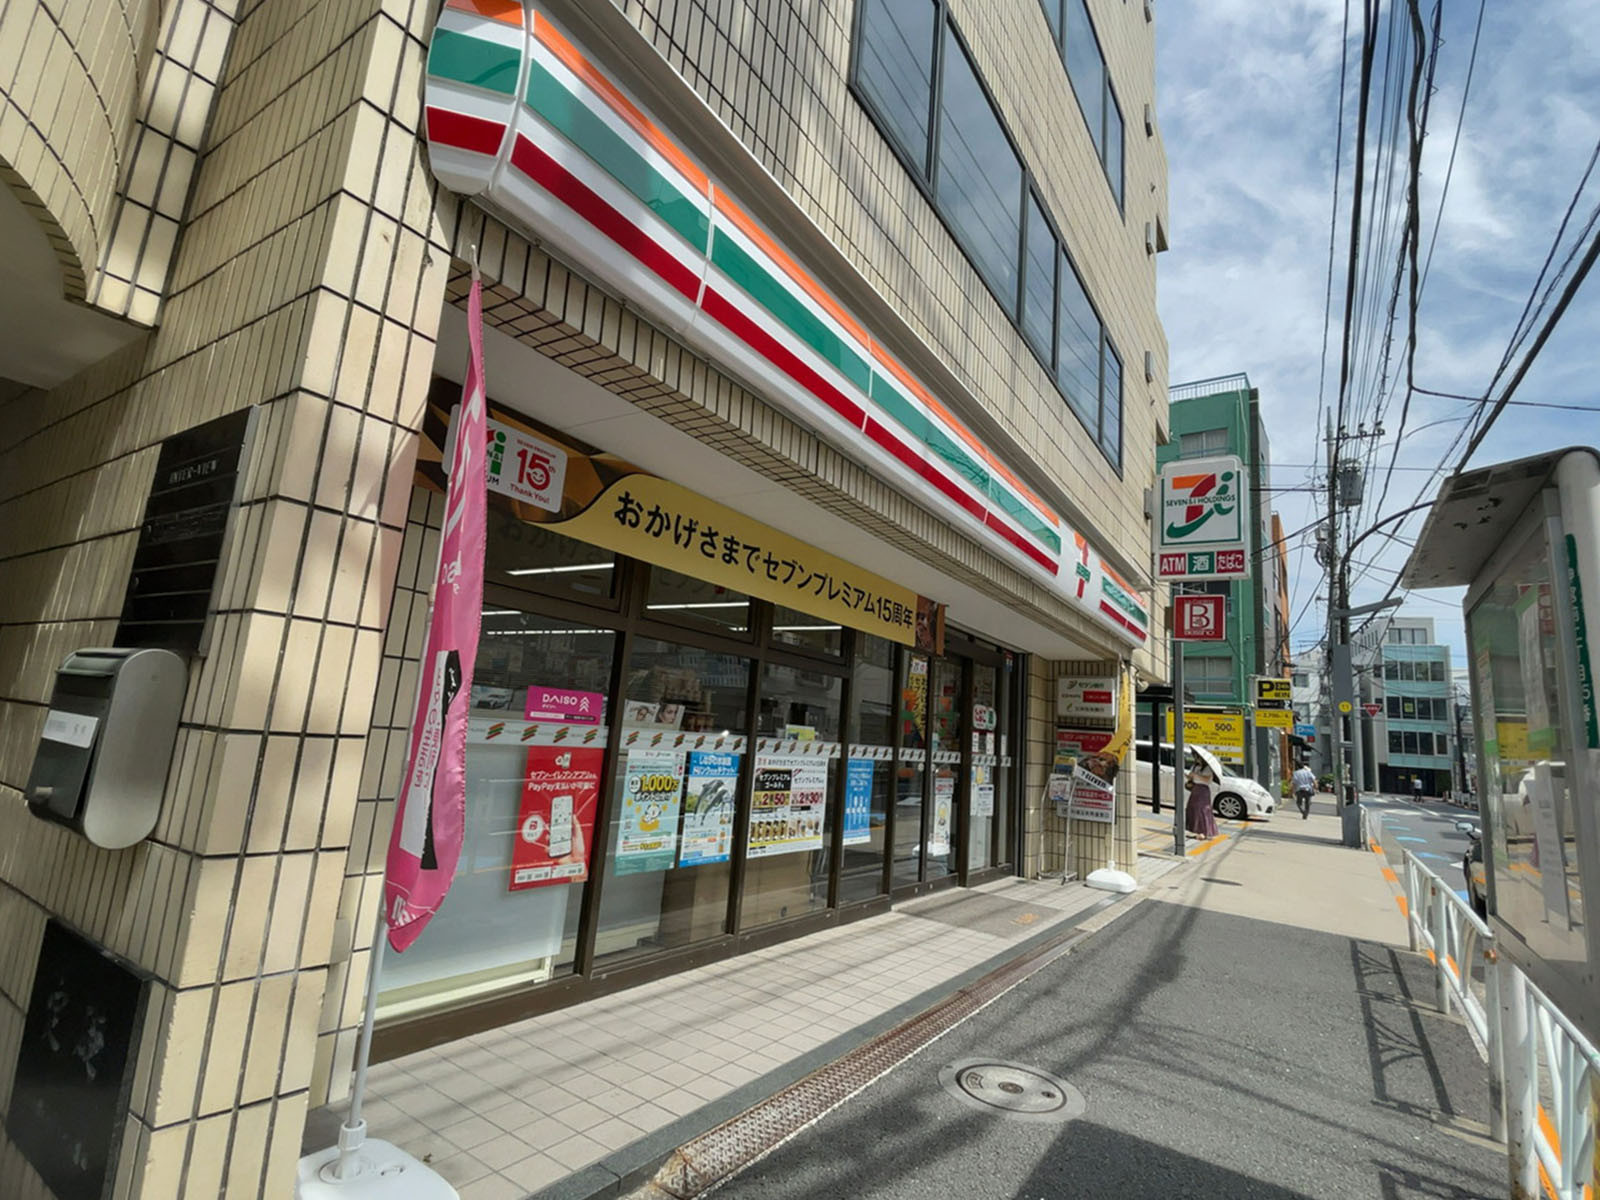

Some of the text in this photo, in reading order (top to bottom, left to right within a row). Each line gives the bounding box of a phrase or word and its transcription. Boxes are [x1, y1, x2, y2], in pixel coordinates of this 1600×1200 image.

[510, 483, 533, 497] Thank
[1197, 494, 1236, 505] HOLDINGS
[614, 491, 914, 629] おかげさまでセブンプレミアム15周年
[1161, 556, 1185, 573] ATM
[1192, 555, 1210, 571] 酒
[1217, 554, 1244, 570] たばこ
[1258, 680, 1274, 698] P
[542, 693, 578, 706] DAISO
[1215, 723, 1233, 731] 500
